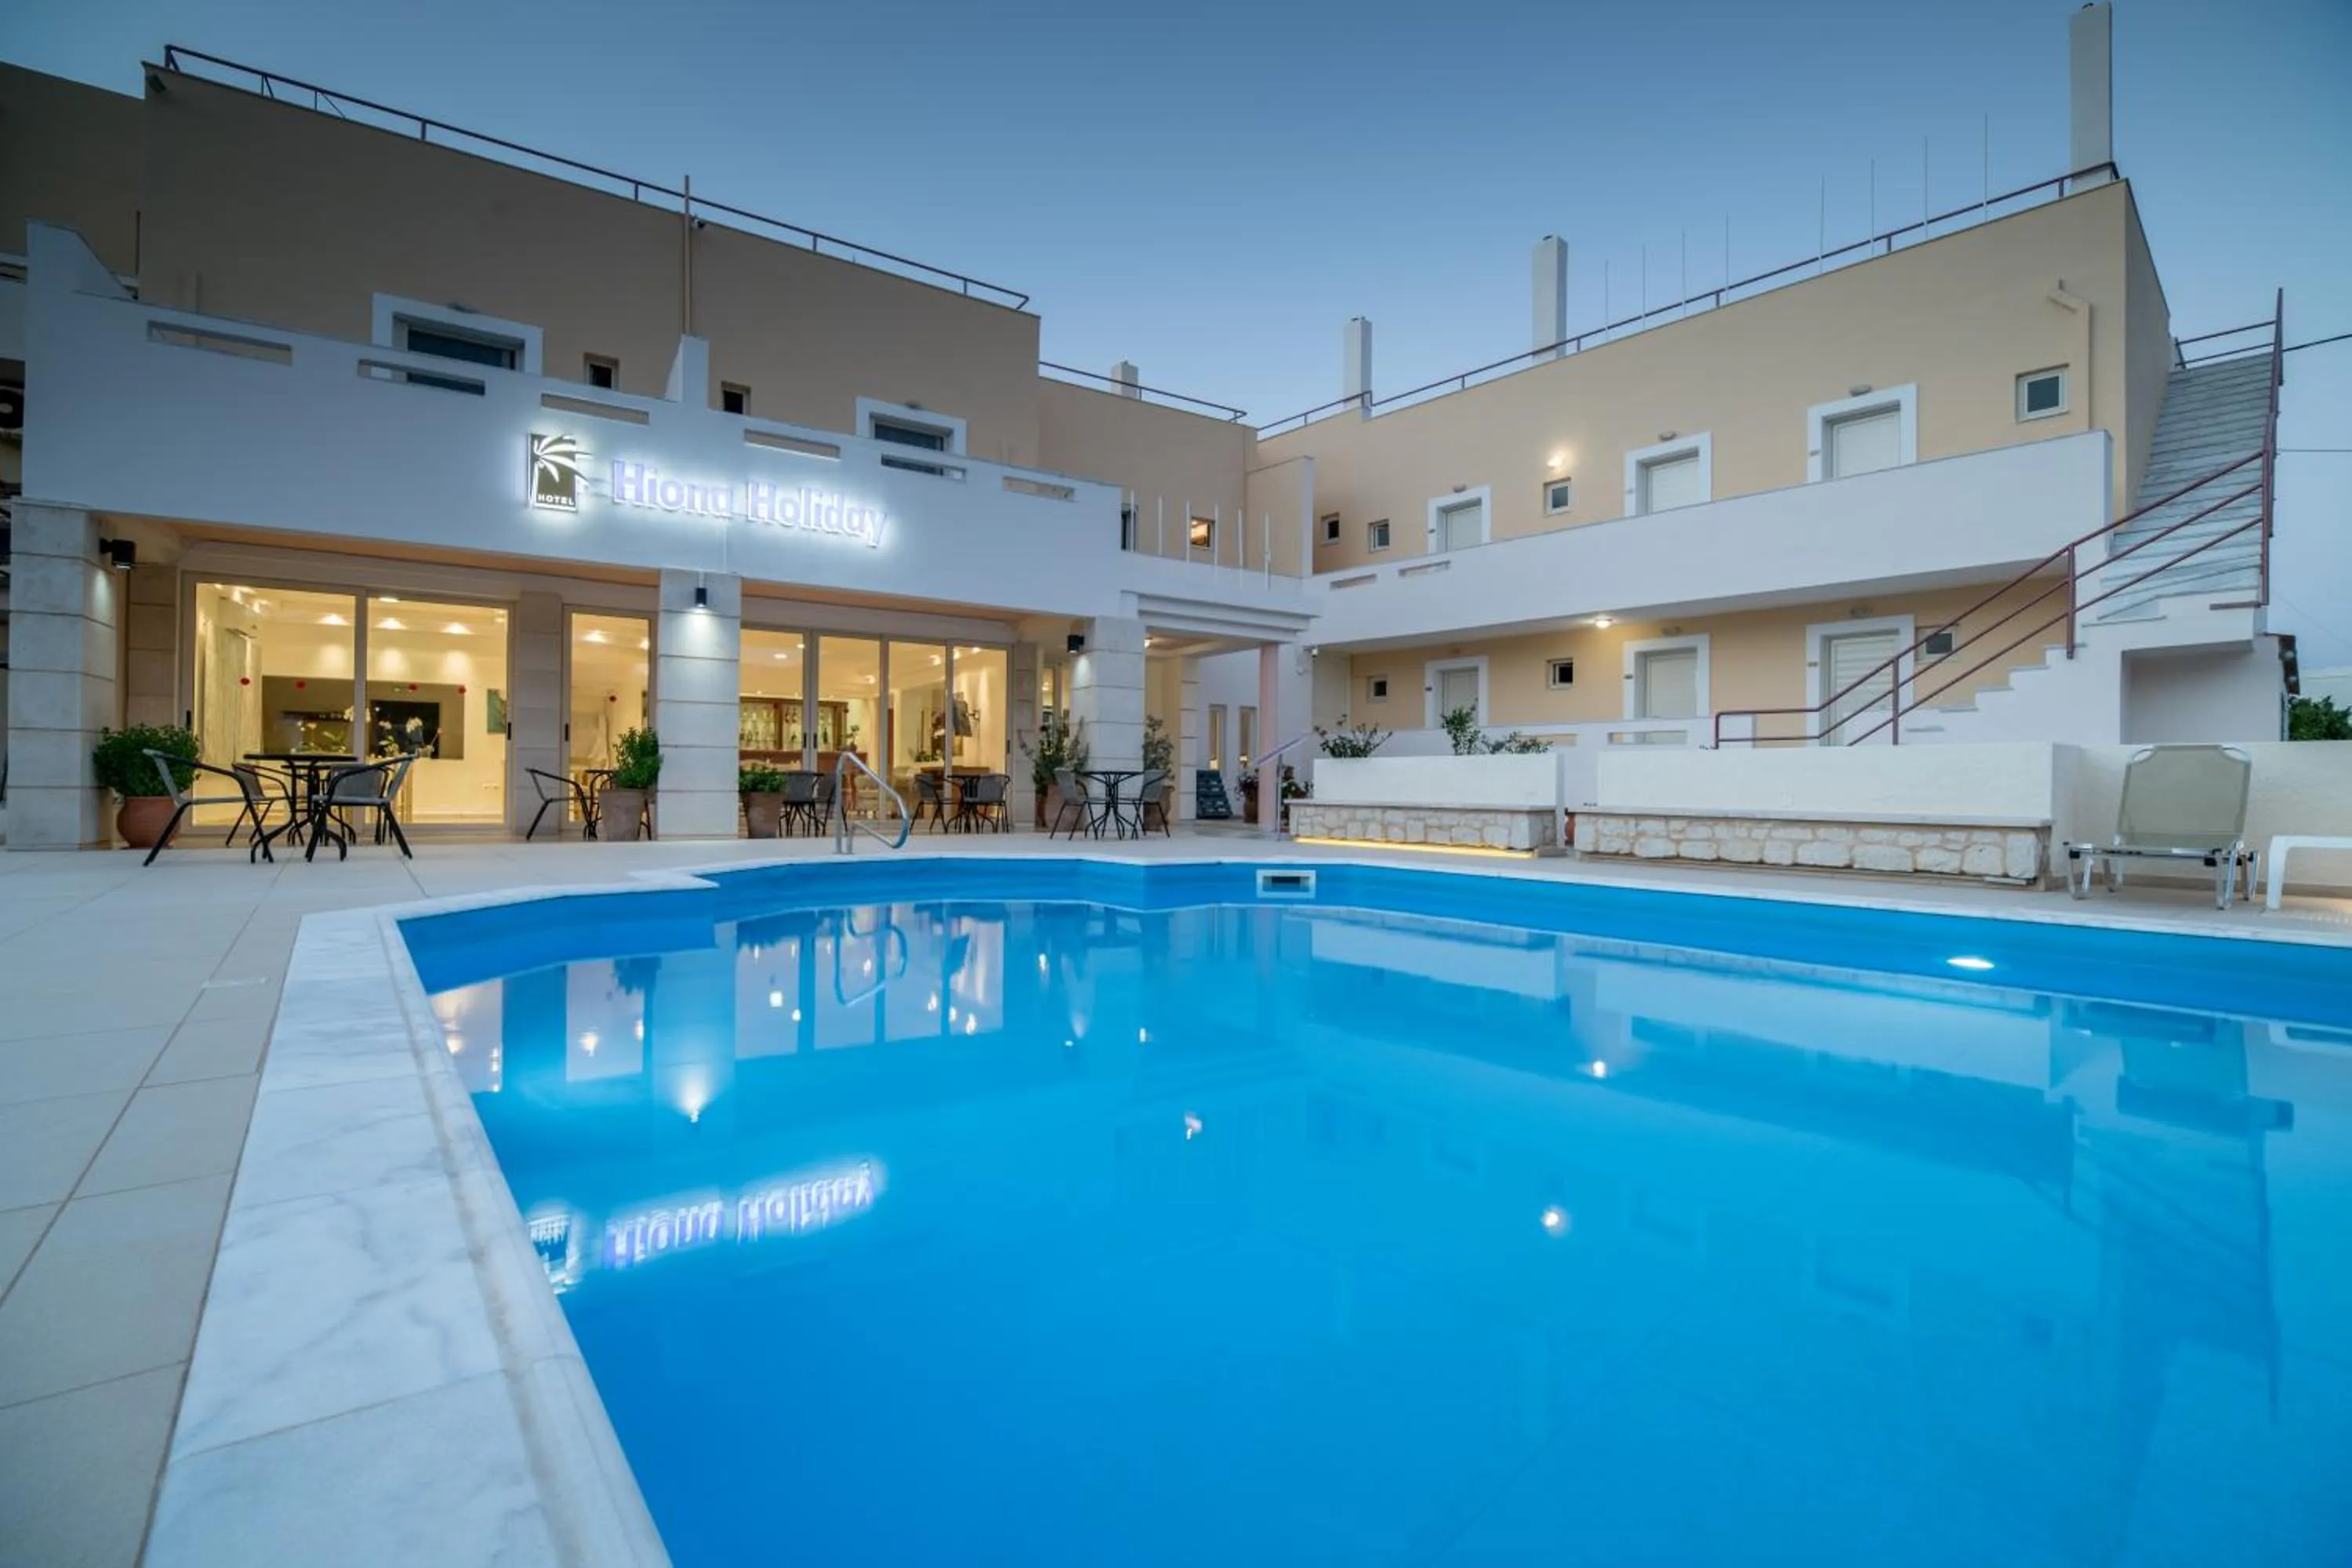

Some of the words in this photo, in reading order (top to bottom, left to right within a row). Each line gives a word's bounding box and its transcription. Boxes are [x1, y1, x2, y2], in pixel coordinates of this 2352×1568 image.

[537, 492, 575, 506] HOTEL
[613, 459, 733, 518] Hiona
[747, 480, 888, 548] Holiday
